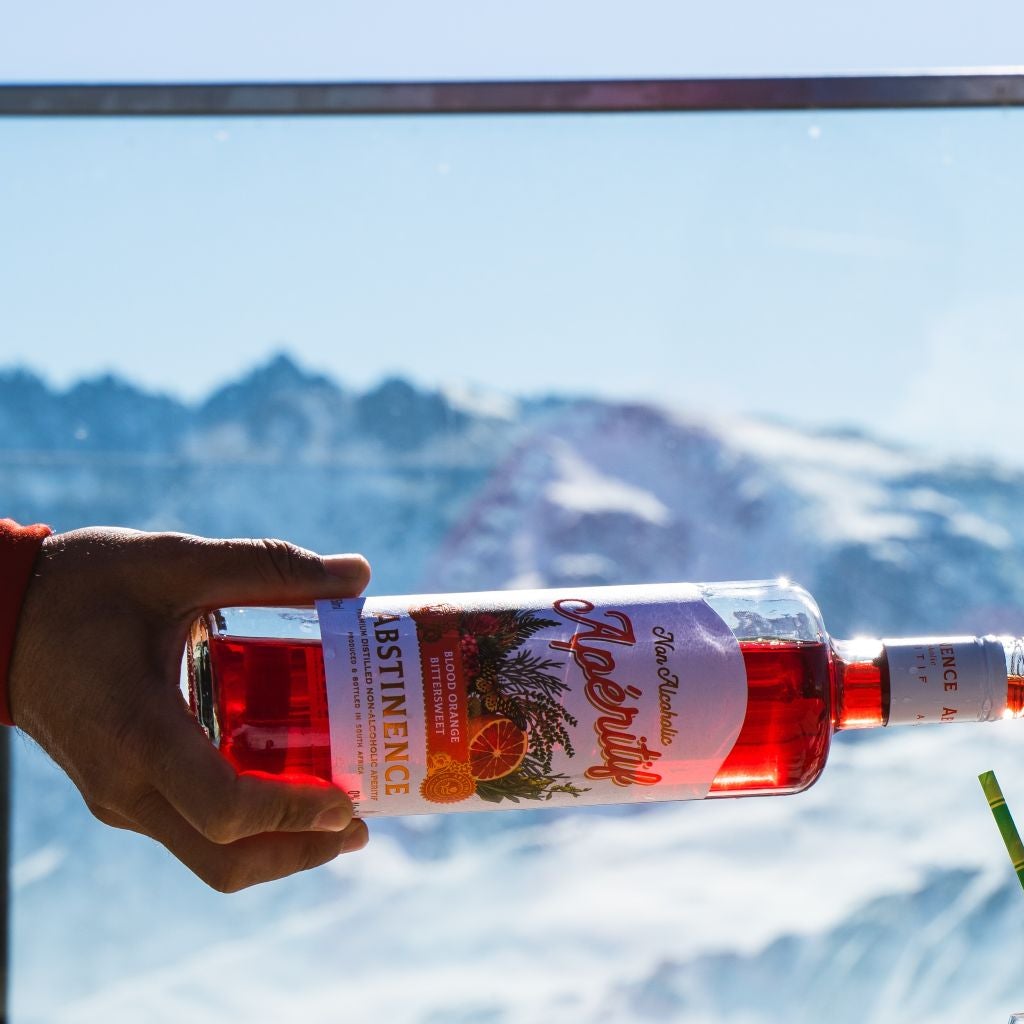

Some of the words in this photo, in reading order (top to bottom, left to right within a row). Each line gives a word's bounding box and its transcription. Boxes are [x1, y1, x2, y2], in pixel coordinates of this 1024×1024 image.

[348, 631, 357, 665] PRODUCED
[361, 638, 373, 685] DISTILLED
[652, 626, 675, 666] Non
[444, 650, 457, 690] BLOOD
[352, 677, 361, 709] BOTTLED
[373, 611, 411, 797] ABSTINENCE
[430, 656, 445, 736] BITTERSWEET
[548, 599, 663, 788] Apéritif
[656, 668, 680, 747] Alcoholic
[354, 711, 362, 720] IN
[355, 723, 364, 748] SOUTH
[366, 687, 378, 768] NON-ALCOHOLIC
[448, 694, 460, 744] ORANGE
[356, 750, 365, 775] AFRICA
[369, 769, 379, 801] APERITIF
